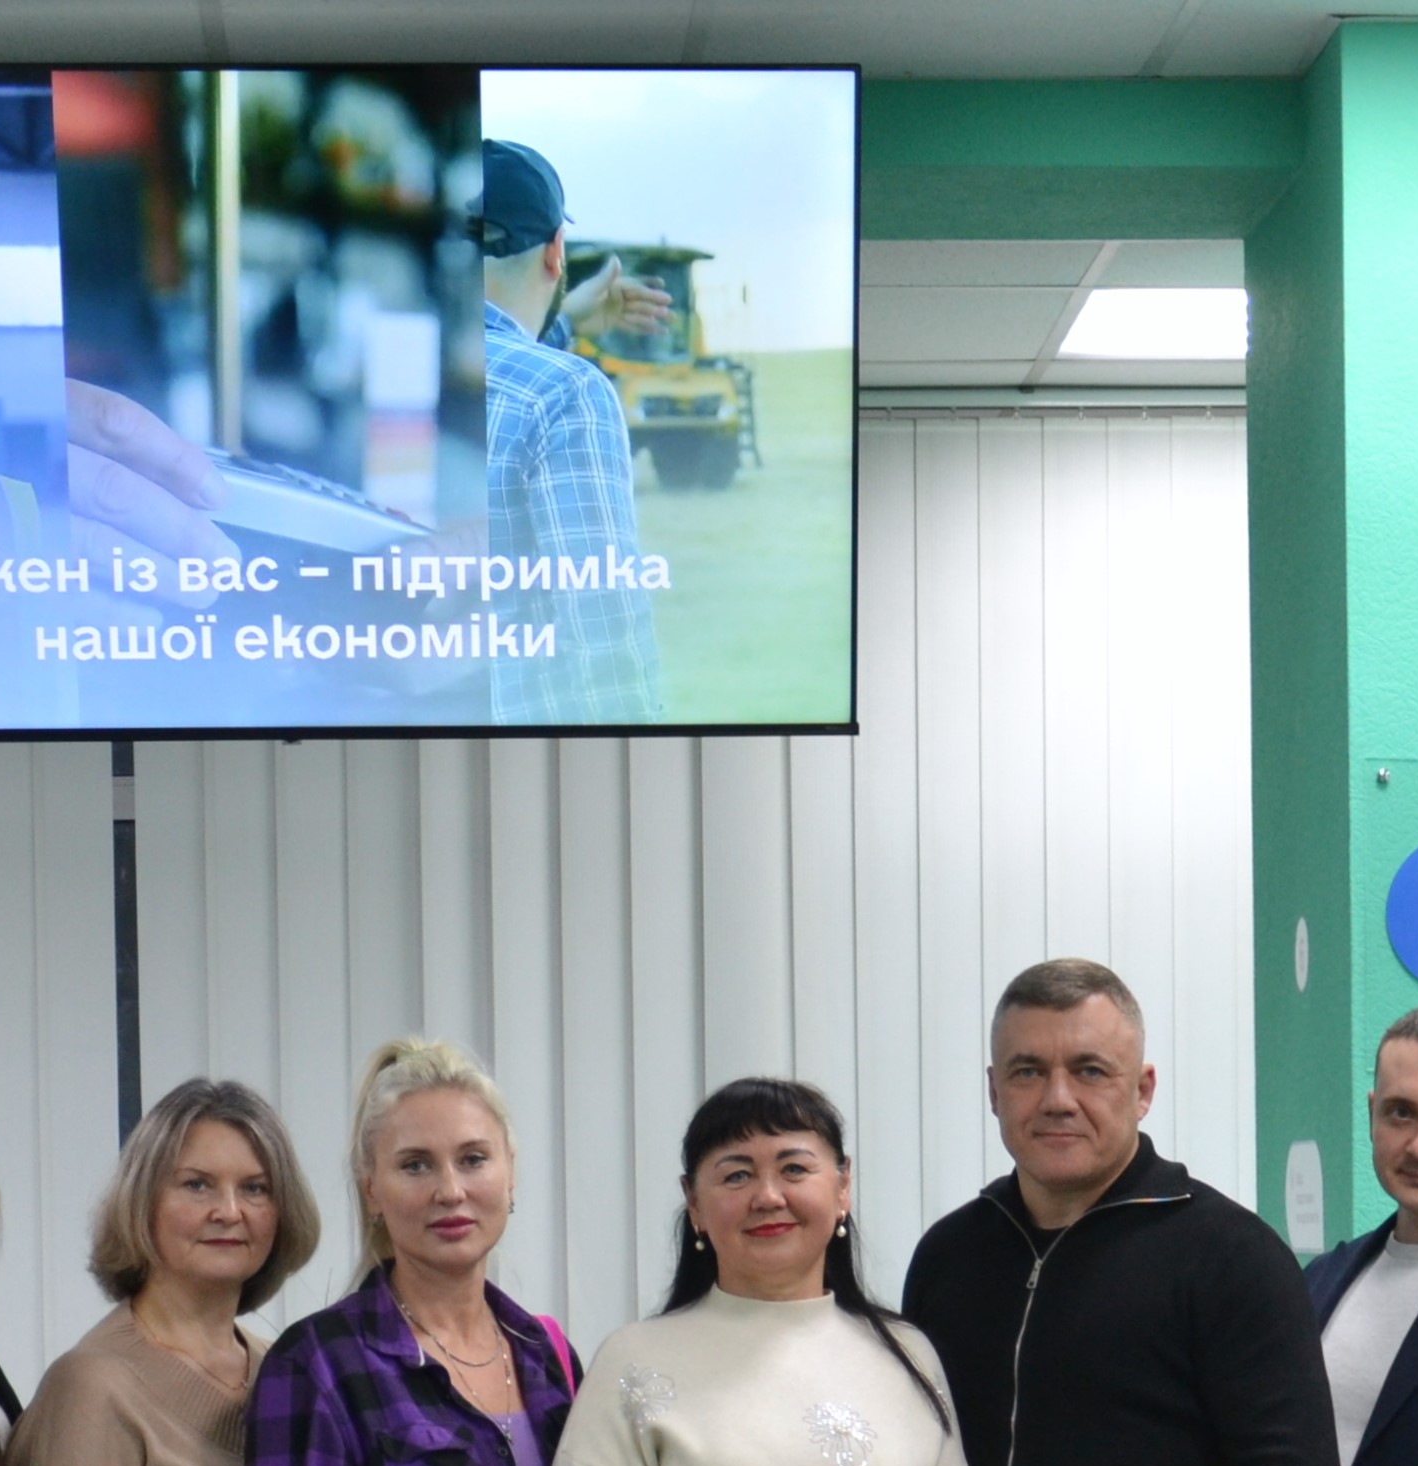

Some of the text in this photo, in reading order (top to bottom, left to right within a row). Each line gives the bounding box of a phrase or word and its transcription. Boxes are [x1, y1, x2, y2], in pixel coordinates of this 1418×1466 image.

[112, 547, 158, 593] із
[178, 556, 279, 593] вас
[352, 544, 672, 602] підтримка
[35, 613, 556, 661] нашої економіки
